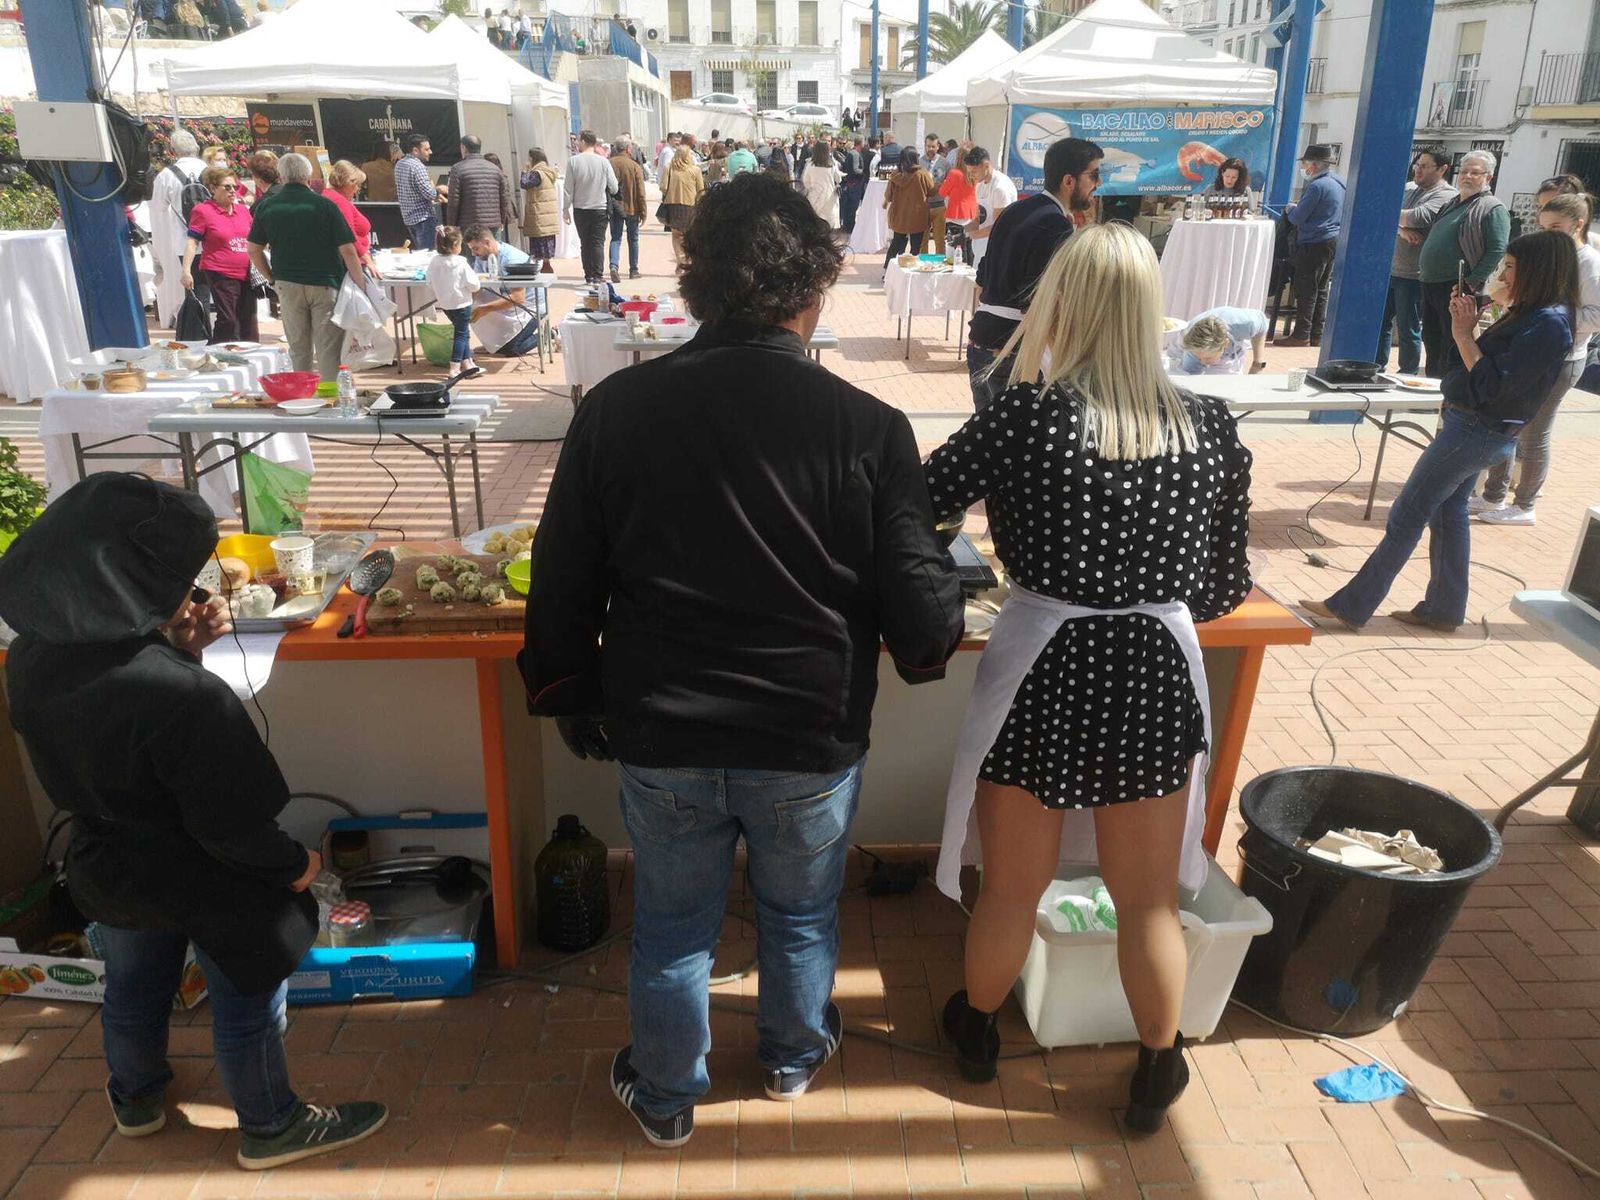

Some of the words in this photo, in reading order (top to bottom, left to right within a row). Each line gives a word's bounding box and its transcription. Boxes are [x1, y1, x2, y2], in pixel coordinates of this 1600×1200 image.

[270, 117, 313, 127] mundaventos
[1081, 112, 1166, 130] BACALAO
[1174, 110, 1264, 130] MARISCO
[1021, 142, 1048, 151] ALBAC
[52, 967, 95, 980] Jiménez
